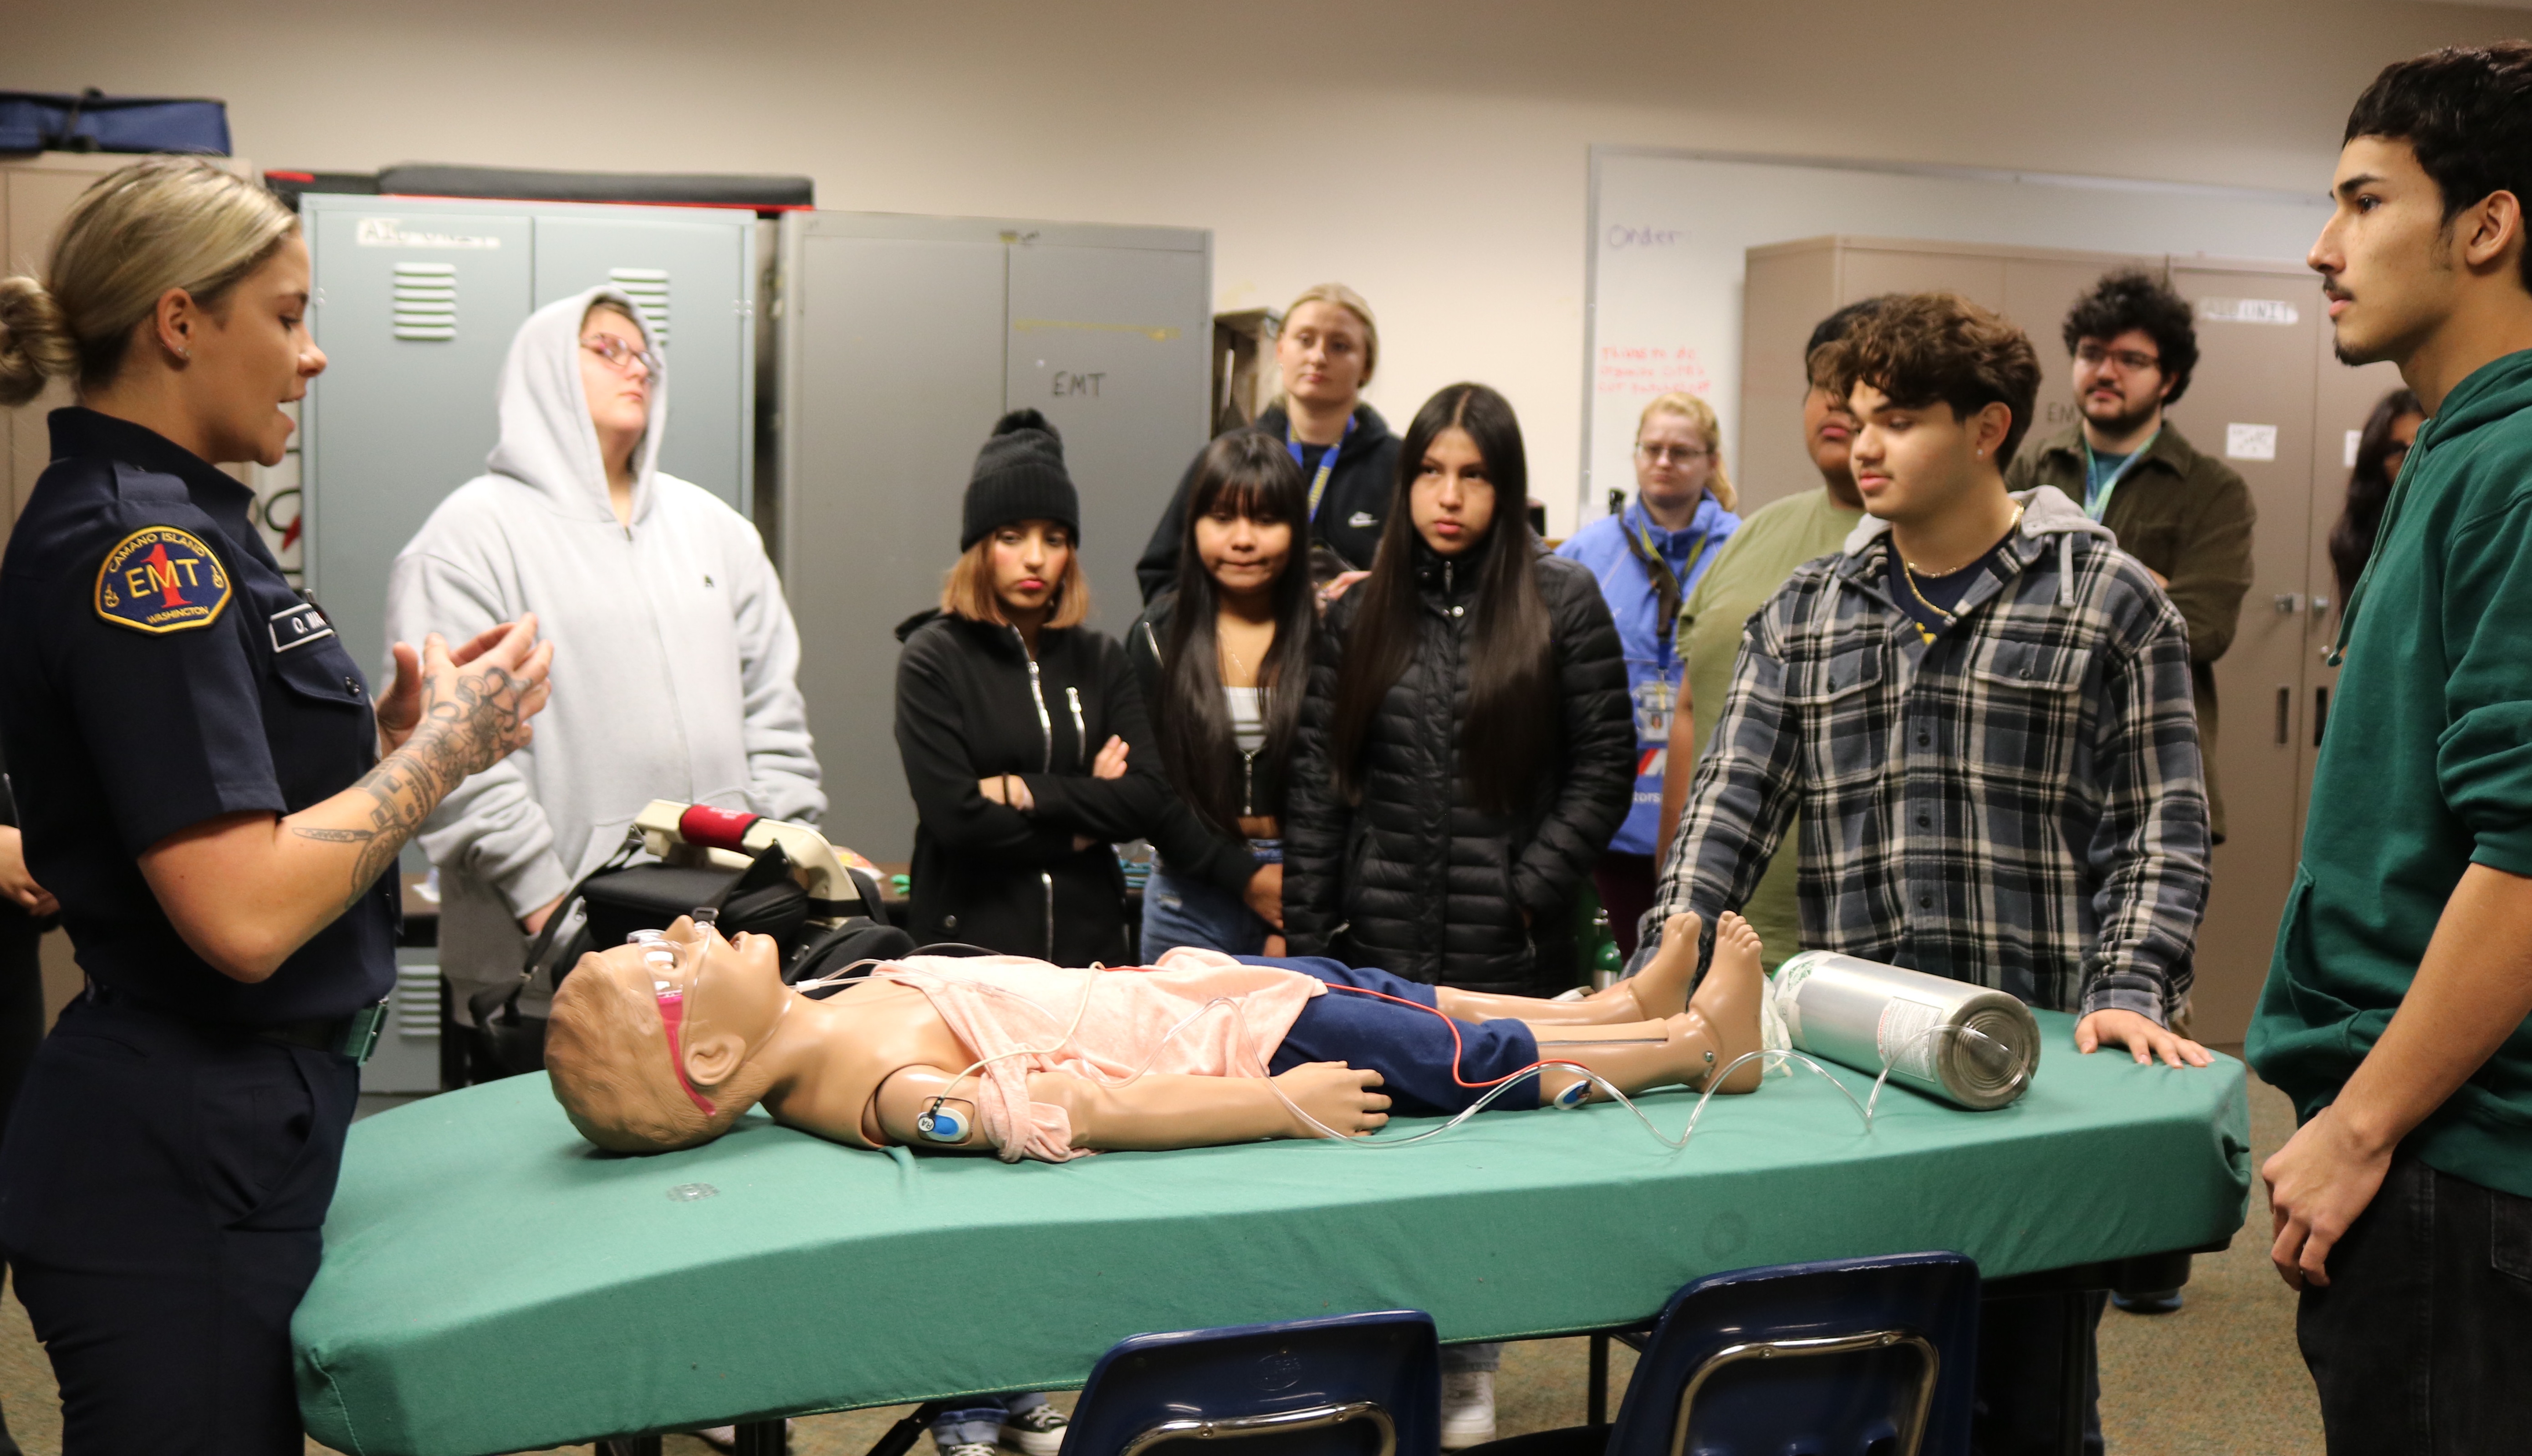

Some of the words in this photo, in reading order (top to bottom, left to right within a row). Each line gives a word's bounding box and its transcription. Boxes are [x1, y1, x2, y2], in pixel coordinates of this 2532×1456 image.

[1053, 371, 1107, 397] EMT
[2047, 402, 2077, 423] EM
[108, 533, 158, 573] CAMANO
[160, 532, 205, 557] ISLAND
[125, 558, 200, 598] EMT
[146, 606, 209, 624] WASHINGTON
[1878, 1009, 1889, 1044] WARNING
[921, 1119, 933, 1130] RA
